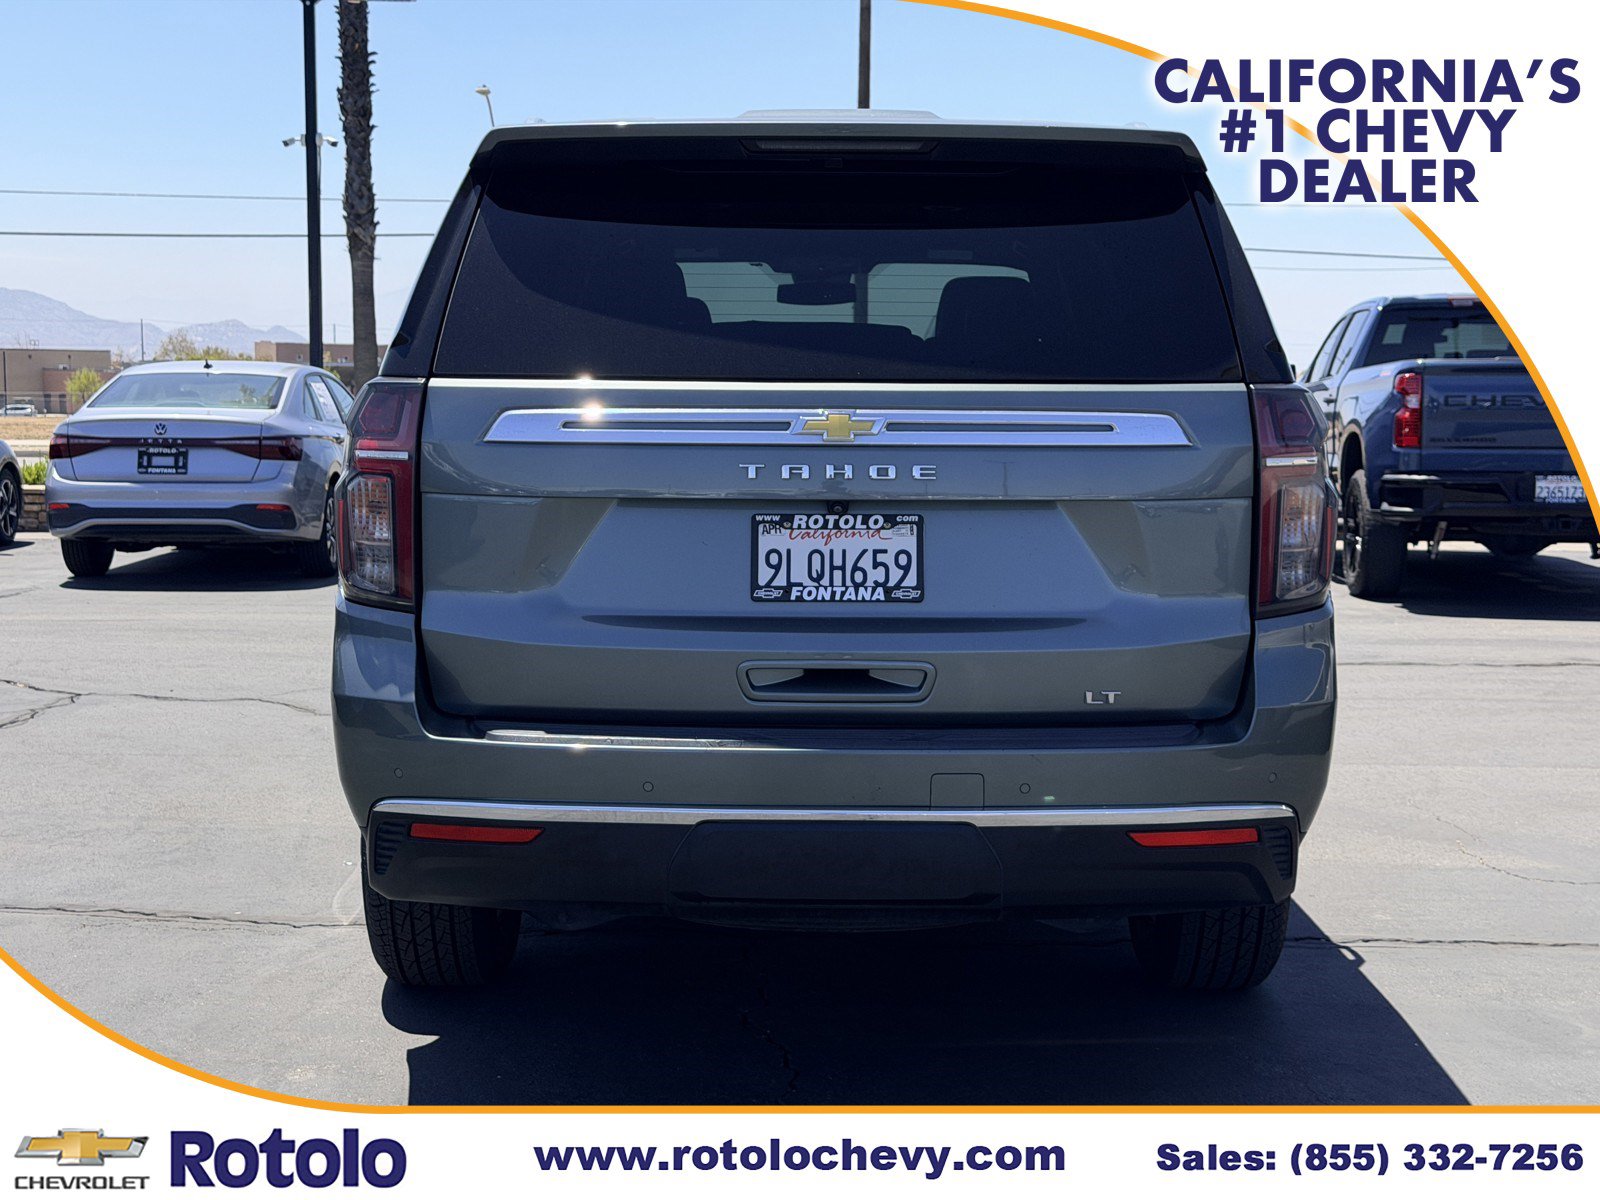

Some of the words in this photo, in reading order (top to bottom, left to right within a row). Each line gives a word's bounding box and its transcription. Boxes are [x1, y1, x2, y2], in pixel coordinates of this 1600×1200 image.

[738, 463, 938, 480] TAHOE
[755, 514, 781, 522] www
[792, 514, 885, 529] ROTOLO
[896, 514, 919, 522] com
[762, 523, 782, 535] APR
[788, 528, 893, 546] California
[764, 548, 913, 587] 9LQH659
[790, 586, 886, 601] FONTANA
[1085, 690, 1122, 704] LT
